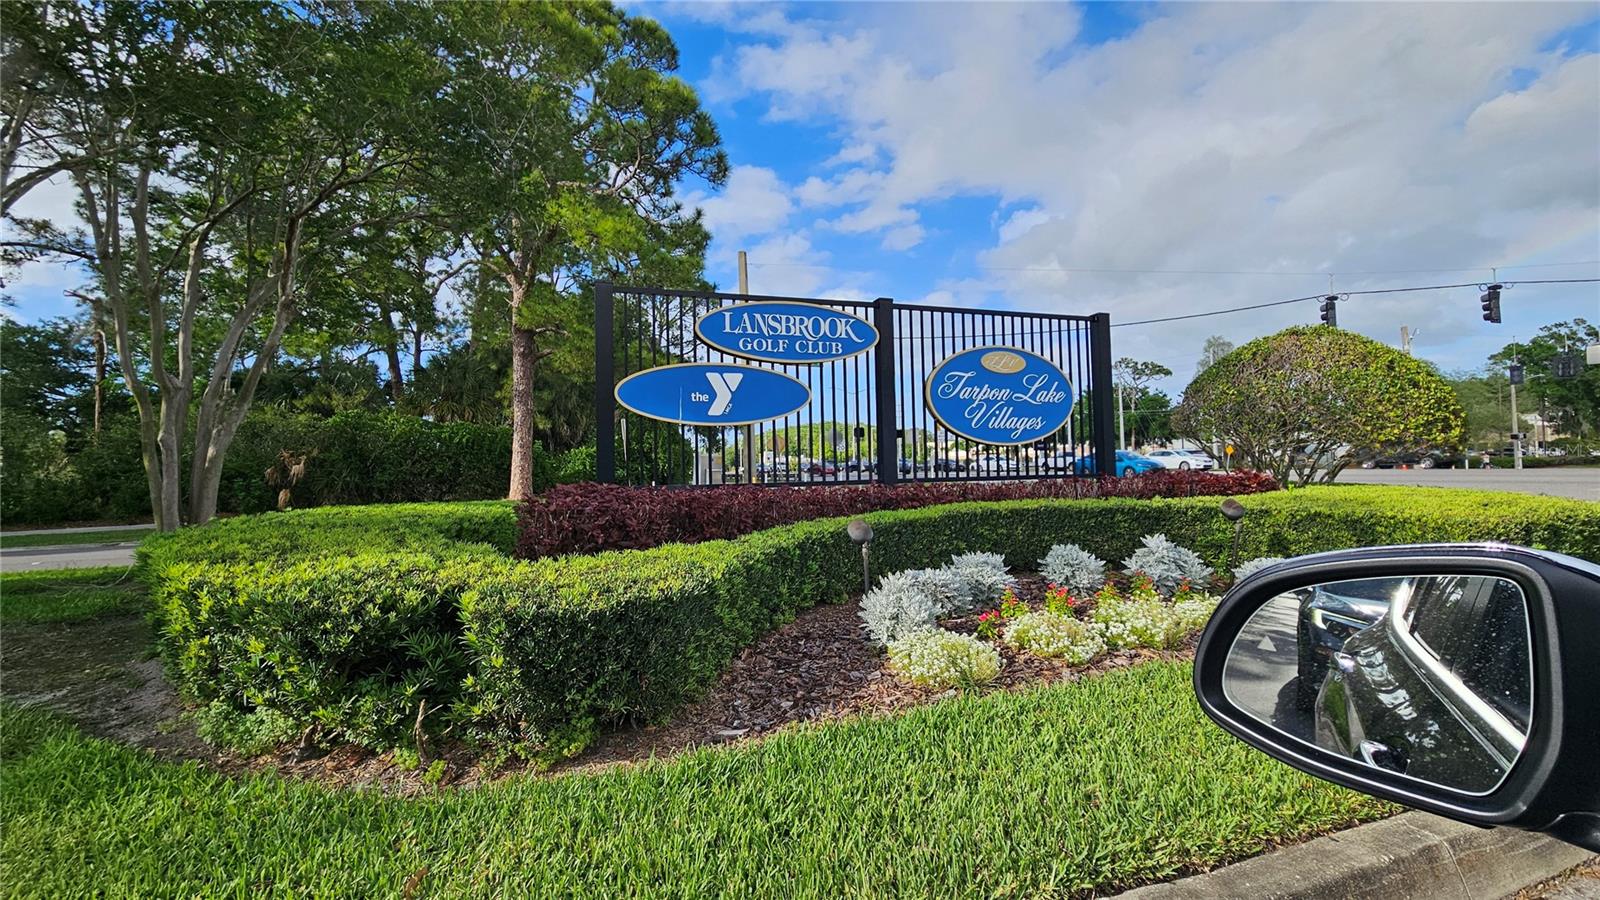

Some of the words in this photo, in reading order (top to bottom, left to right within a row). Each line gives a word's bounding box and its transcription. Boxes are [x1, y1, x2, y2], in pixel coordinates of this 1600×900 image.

[723, 312, 865, 343] LANSBROOK
[738, 338, 789, 353] GOLF
[795, 341, 843, 355] CLUB
[691, 392, 709, 402] the
[937, 370, 1013, 408] Tarpon
[1012, 373, 1067, 405] Lake
[964, 401, 1046, 440] Villages
